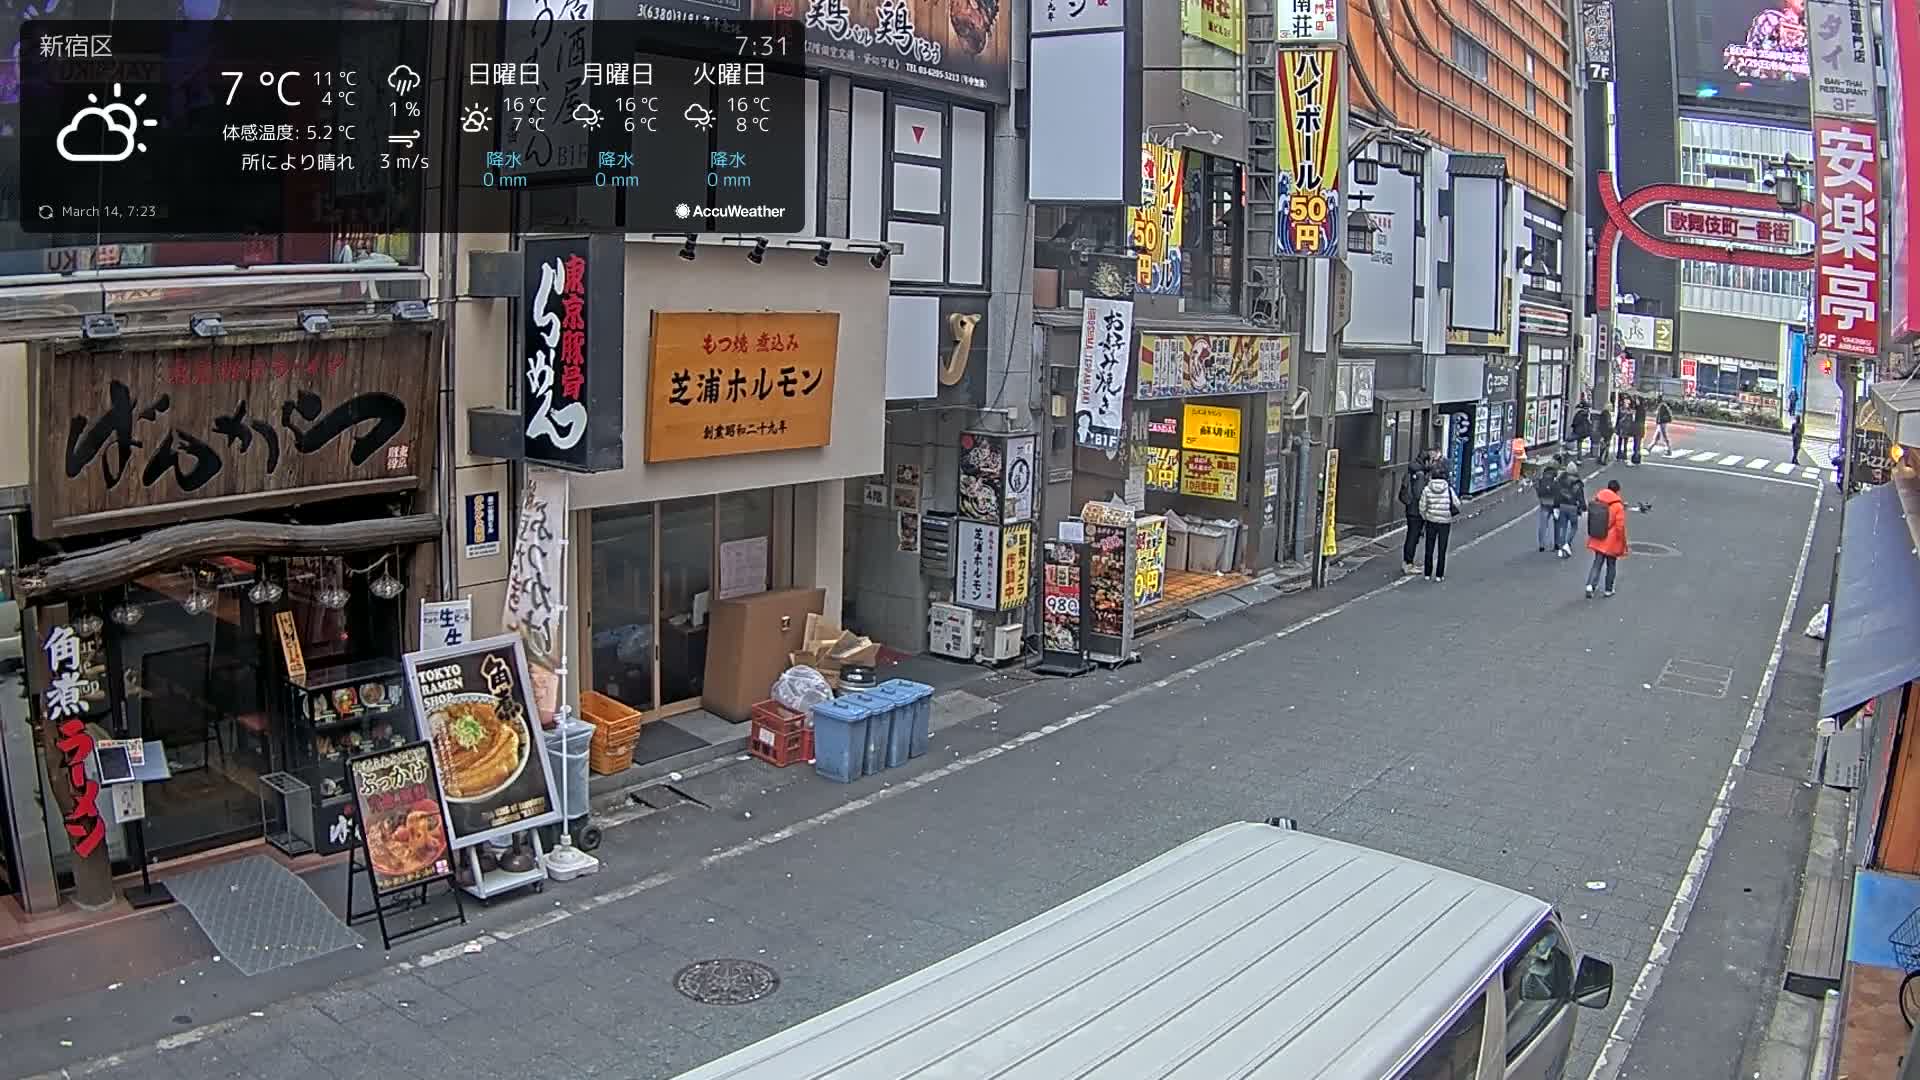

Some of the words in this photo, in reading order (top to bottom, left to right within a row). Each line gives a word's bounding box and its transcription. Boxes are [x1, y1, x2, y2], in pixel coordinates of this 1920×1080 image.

[1590, 63, 1610, 79] 7F
[1832, 97, 1856, 112] 3F
[1296, 54, 1323, 192] ハイボール
[1289, 194, 1328, 222] 50
[1295, 224, 1320, 251] 円
[1670, 211, 1791, 242] 歌舞伎町一番街
[1819, 126, 1876, 331] 安楽亭
[562, 254, 585, 400] 東京豚骨
[1818, 332, 1837, 348] 2F
[703, 333, 749, 355] もつ焼
[756, 331, 800, 354] 煮込み
[1094, 311, 1126, 416] お好み焼き
[668, 366, 823, 406] 芝浦ホルモン
[1095, 433, 1118, 448] B1F
[44, 626, 89, 721] 角煮
[418, 663, 461, 684] TOKYO
[420, 676, 465, 696] RAMEN
[423, 692, 454, 708] SHOP
[57, 719, 106, 858] ラーメン
